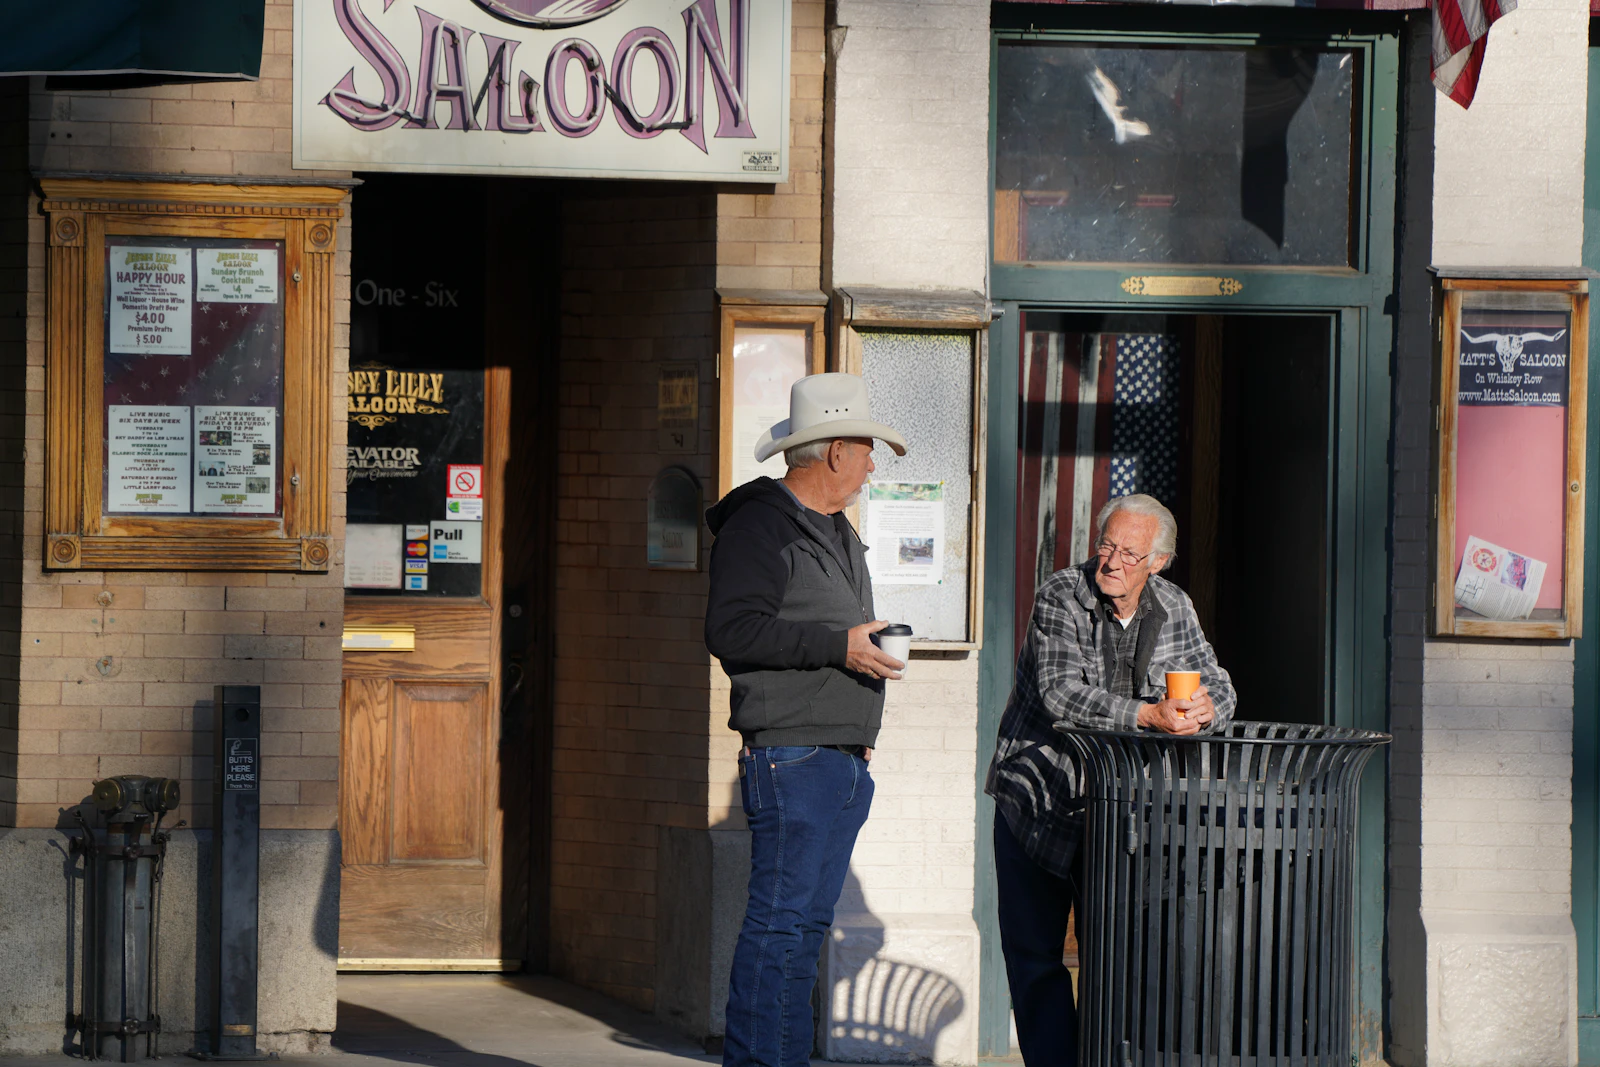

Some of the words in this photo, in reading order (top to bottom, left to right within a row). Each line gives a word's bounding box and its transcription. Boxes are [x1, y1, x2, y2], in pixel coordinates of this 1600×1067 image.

[318, 0, 756, 155] SALOON
[116, 272, 152, 284] HAPPY
[156, 273, 186, 284] HOUR
[211, 268, 237, 277] Sunday
[238, 268, 264, 276] Brunch
[221, 276, 254, 284] Cocktails
[355, 279, 405, 307] One
[425, 281, 459, 307] Six
[136, 312, 165, 325] $4.00
[1520, 354, 1566, 367] SALOON
[1475, 373, 1485, 383] On
[1487, 373, 1522, 387] Whiskey
[1524, 374, 1542, 384] Row
[386, 370, 444, 404] LILLY
[1458, 389, 1560, 402] www.MattsSaloon.com
[347, 460, 414, 469] AILABLE
[369, 469, 418, 481] Convenience
[434, 529, 463, 540] Pull
